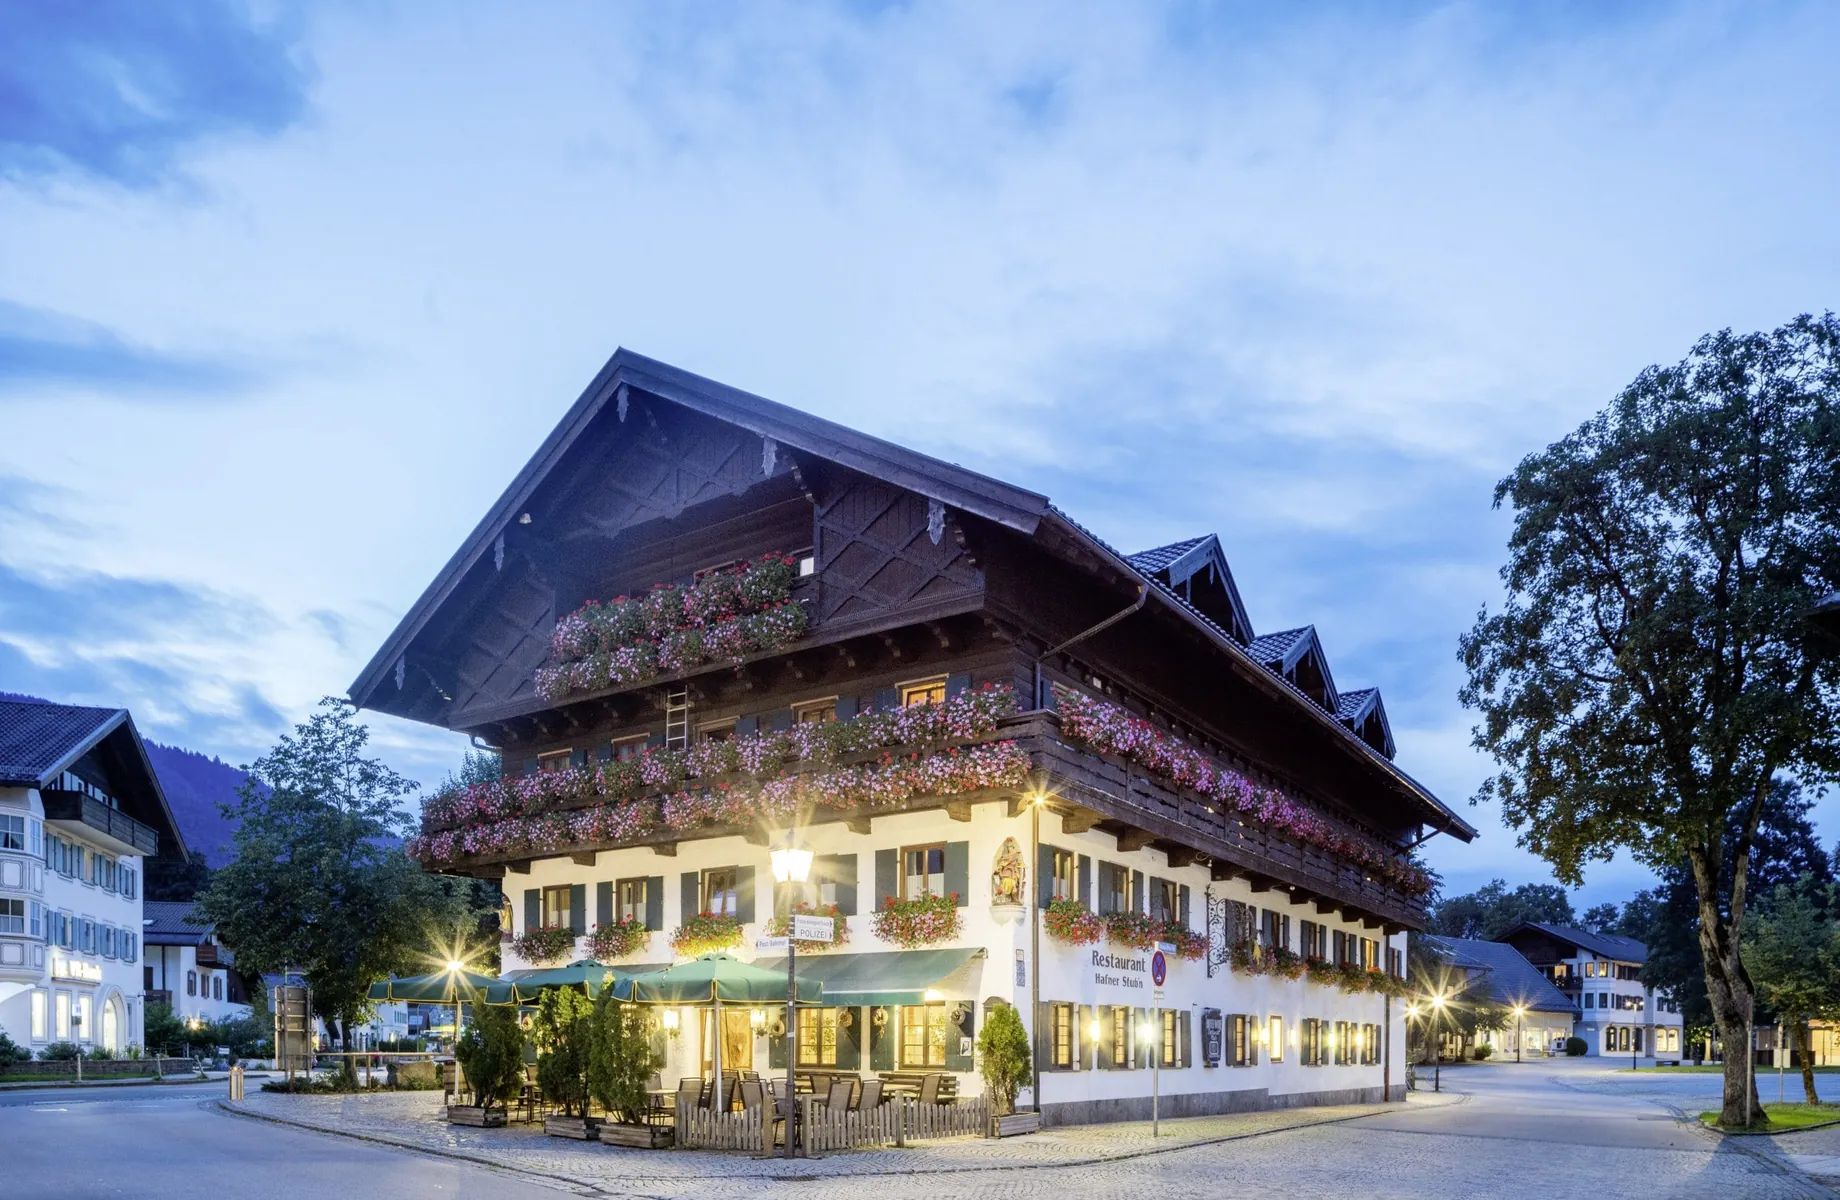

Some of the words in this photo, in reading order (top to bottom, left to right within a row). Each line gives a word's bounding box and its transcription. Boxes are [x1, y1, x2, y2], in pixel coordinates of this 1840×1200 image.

[800, 928, 827, 939] POLIZEI
[1092, 950, 1146, 972] Restaurant
[1095, 973, 1120, 986] Hafner
